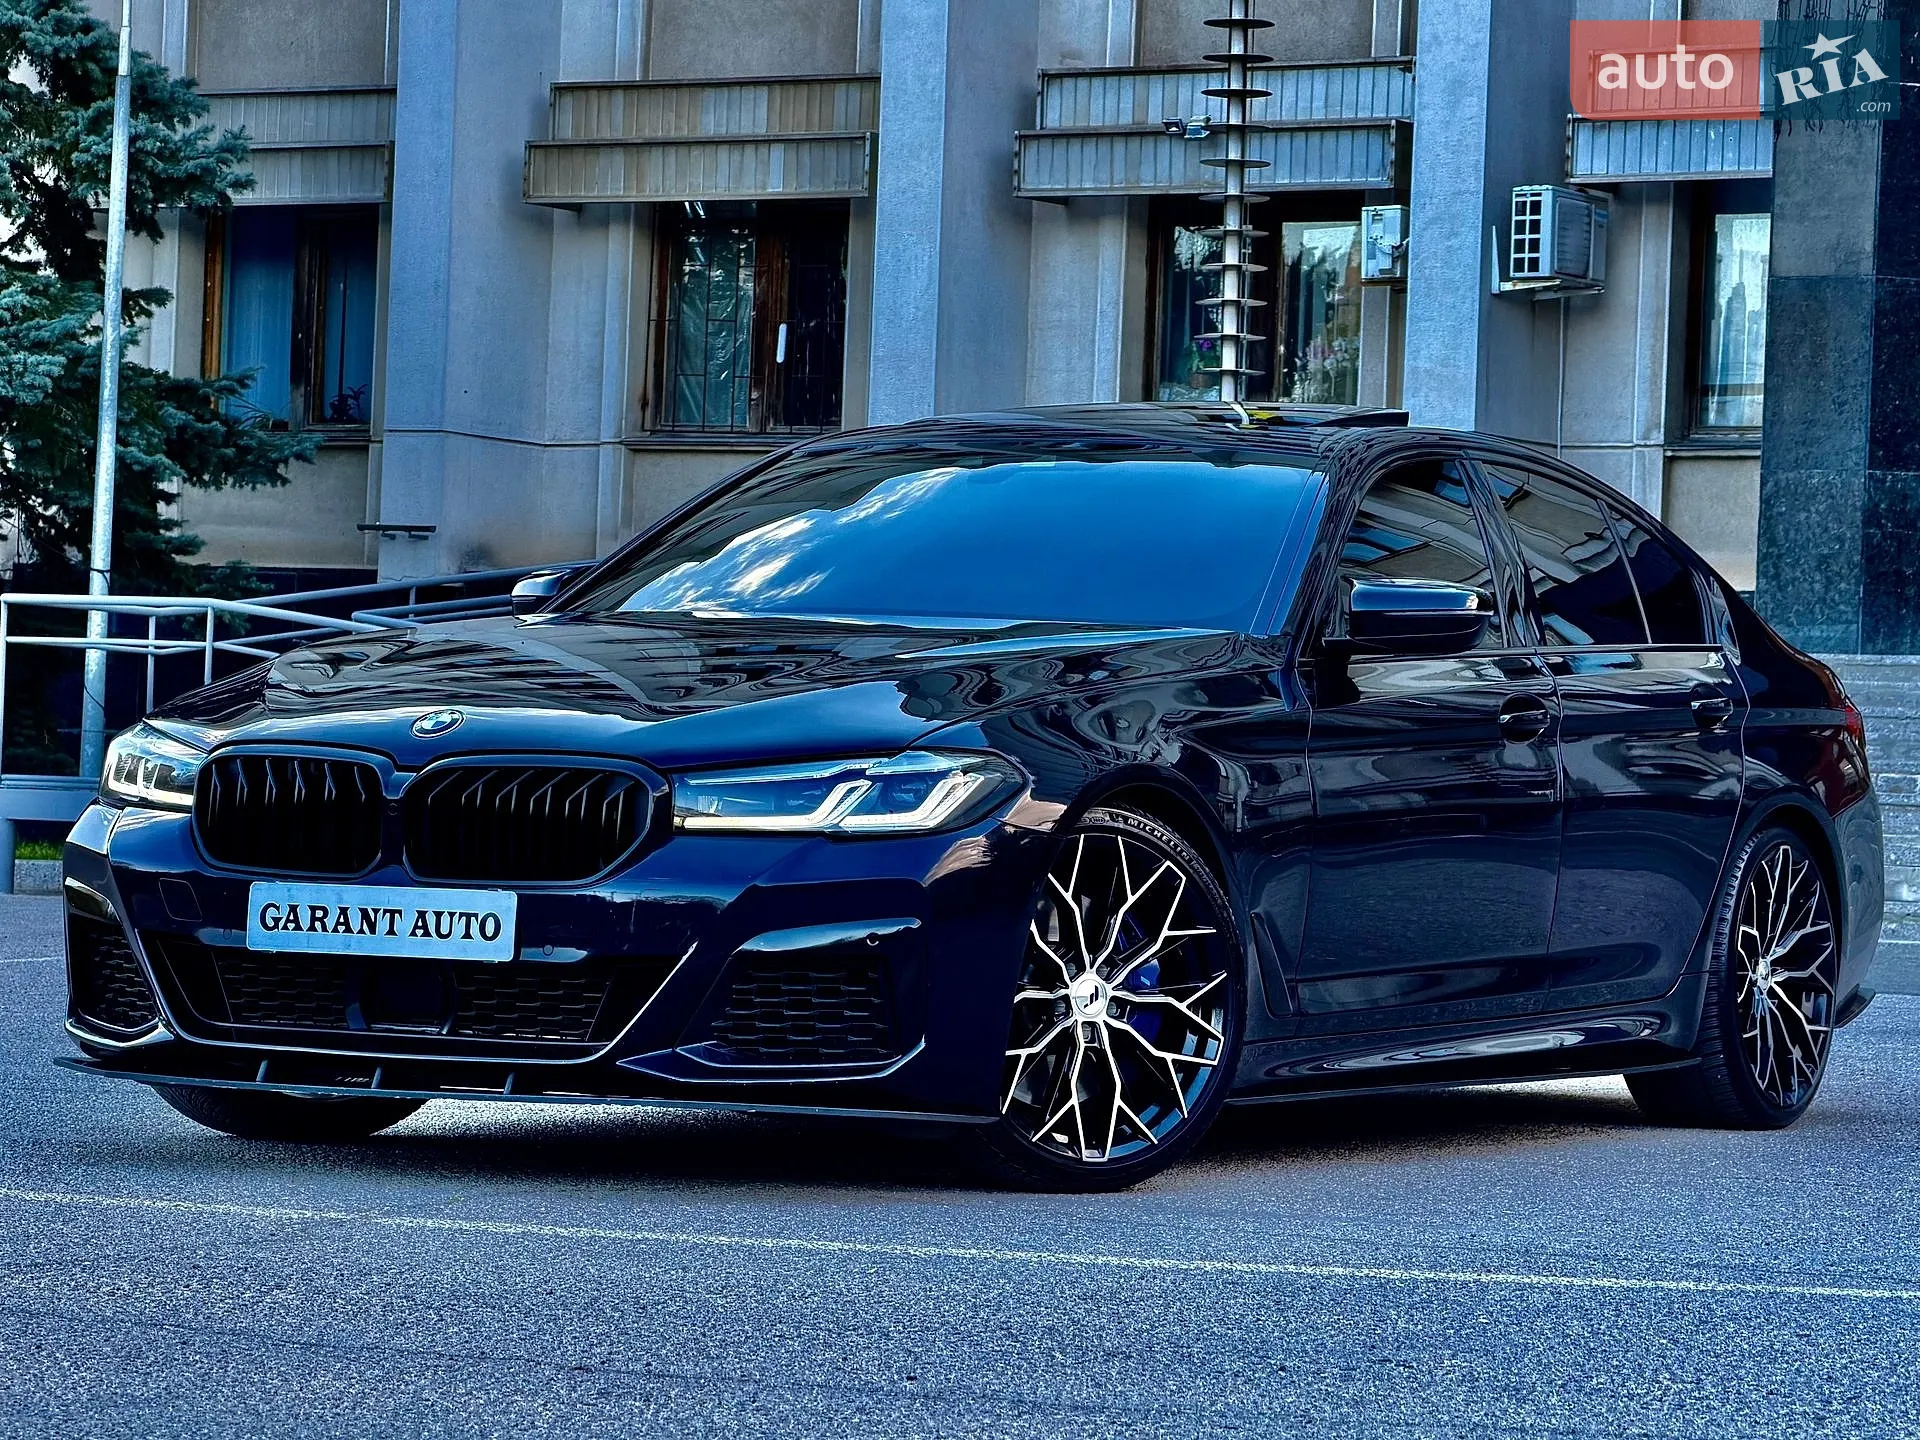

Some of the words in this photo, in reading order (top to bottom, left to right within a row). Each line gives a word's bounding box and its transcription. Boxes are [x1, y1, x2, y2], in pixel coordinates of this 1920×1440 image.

[1127, 818, 1190, 860] MICHELIN
[259, 902, 403, 938] GARANT
[408, 908, 502, 942] AUTO
